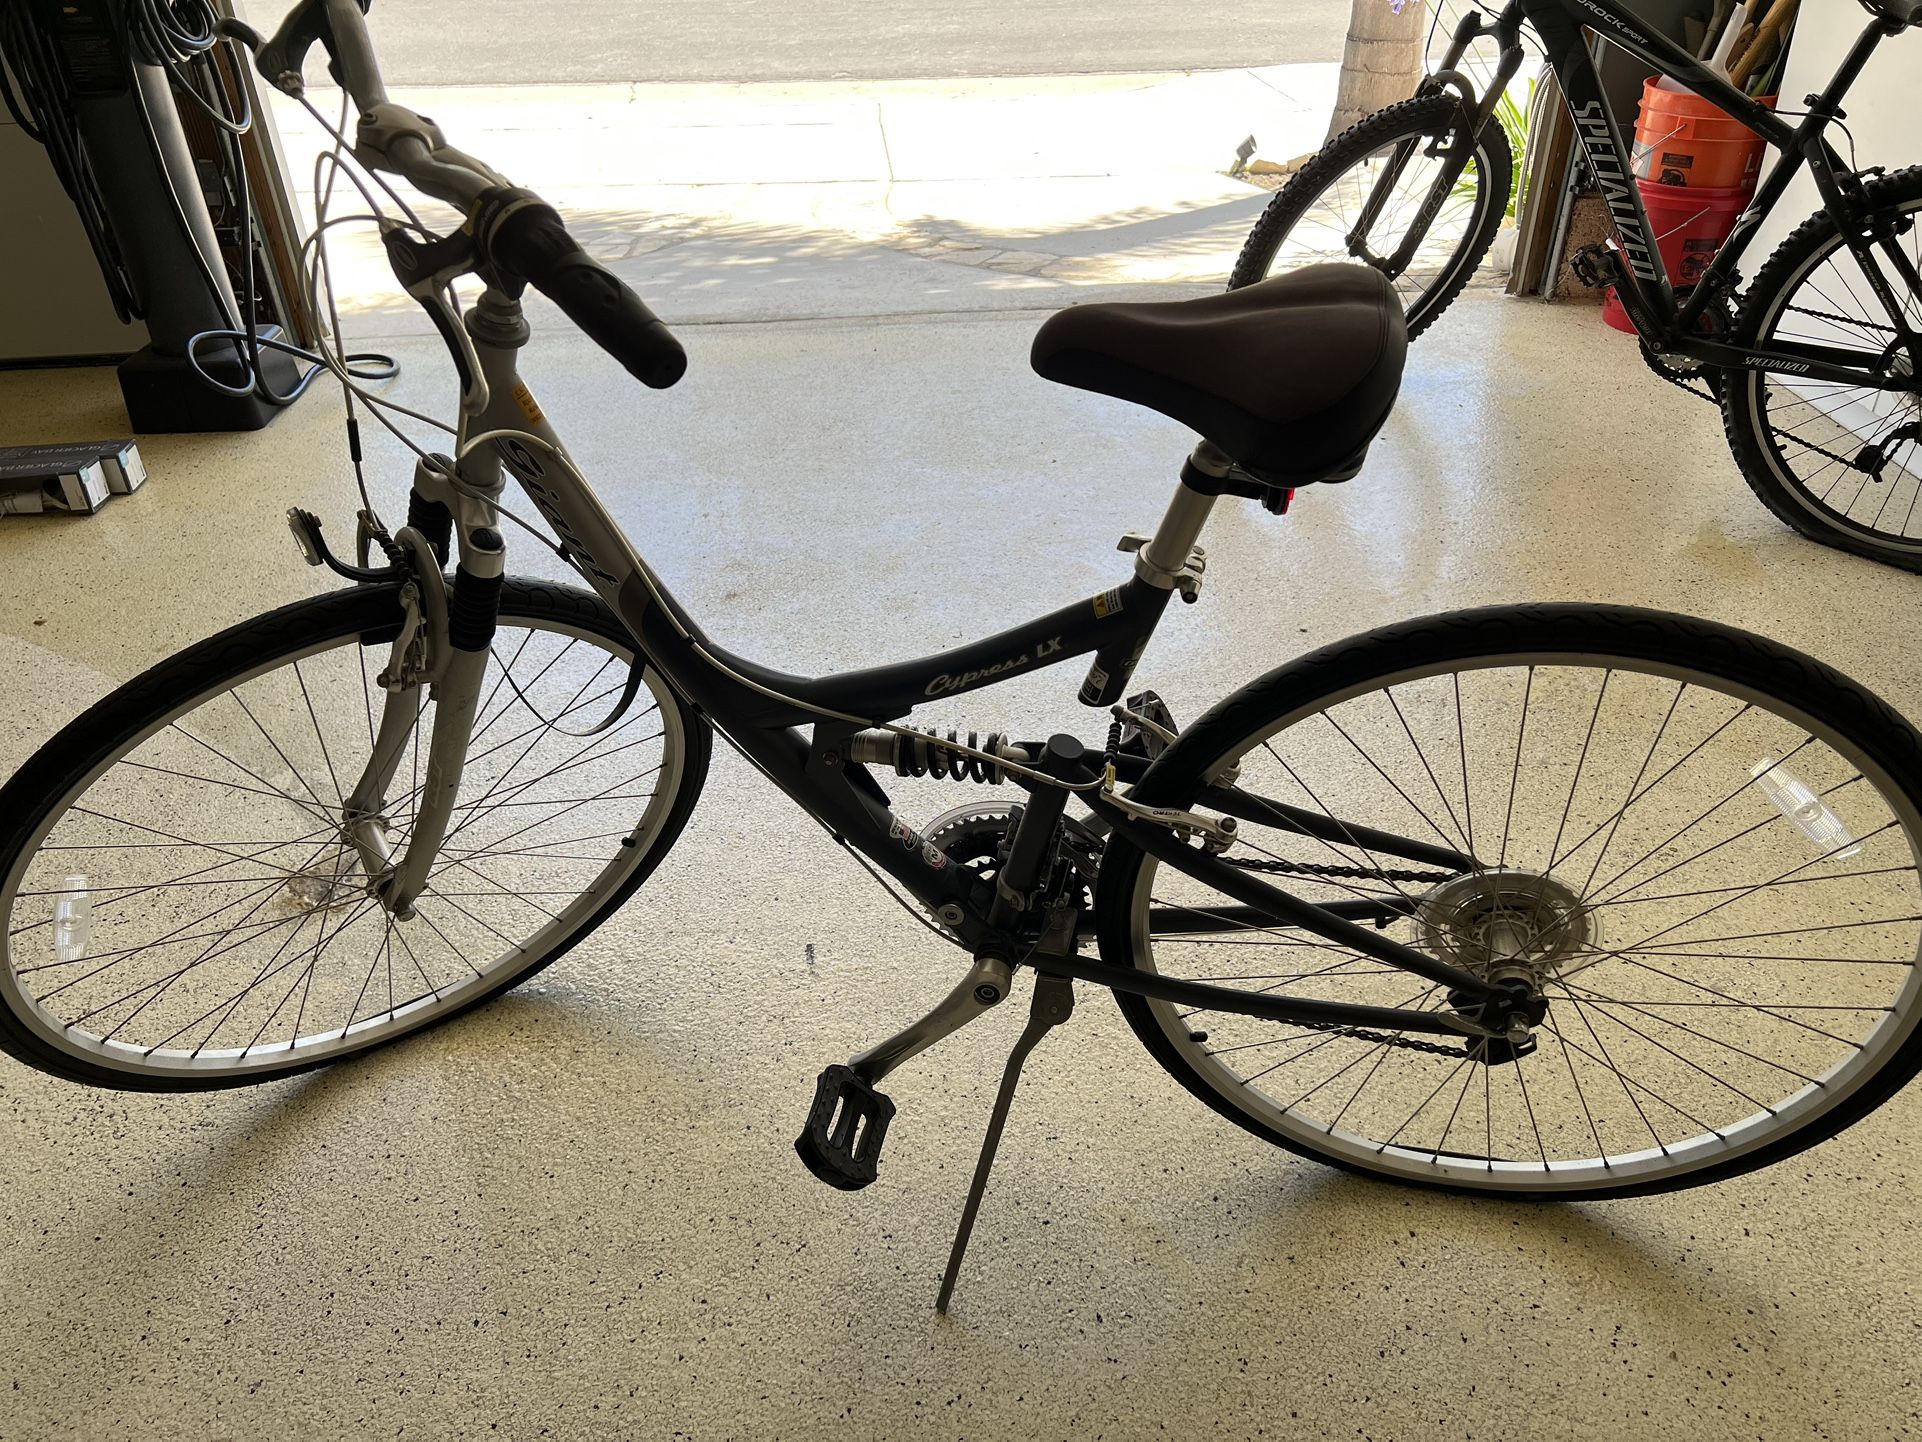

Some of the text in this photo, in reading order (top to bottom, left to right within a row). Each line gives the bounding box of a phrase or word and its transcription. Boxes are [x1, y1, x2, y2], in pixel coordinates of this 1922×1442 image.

[1621, 27, 1649, 44] SPORT
[1423, 175, 1449, 221] RST
[1570, 99, 1657, 283] SPECIALIZED
[1741, 355, 1810, 374] SPECIALIZED
[924, 636, 1065, 697] Cypress LX
